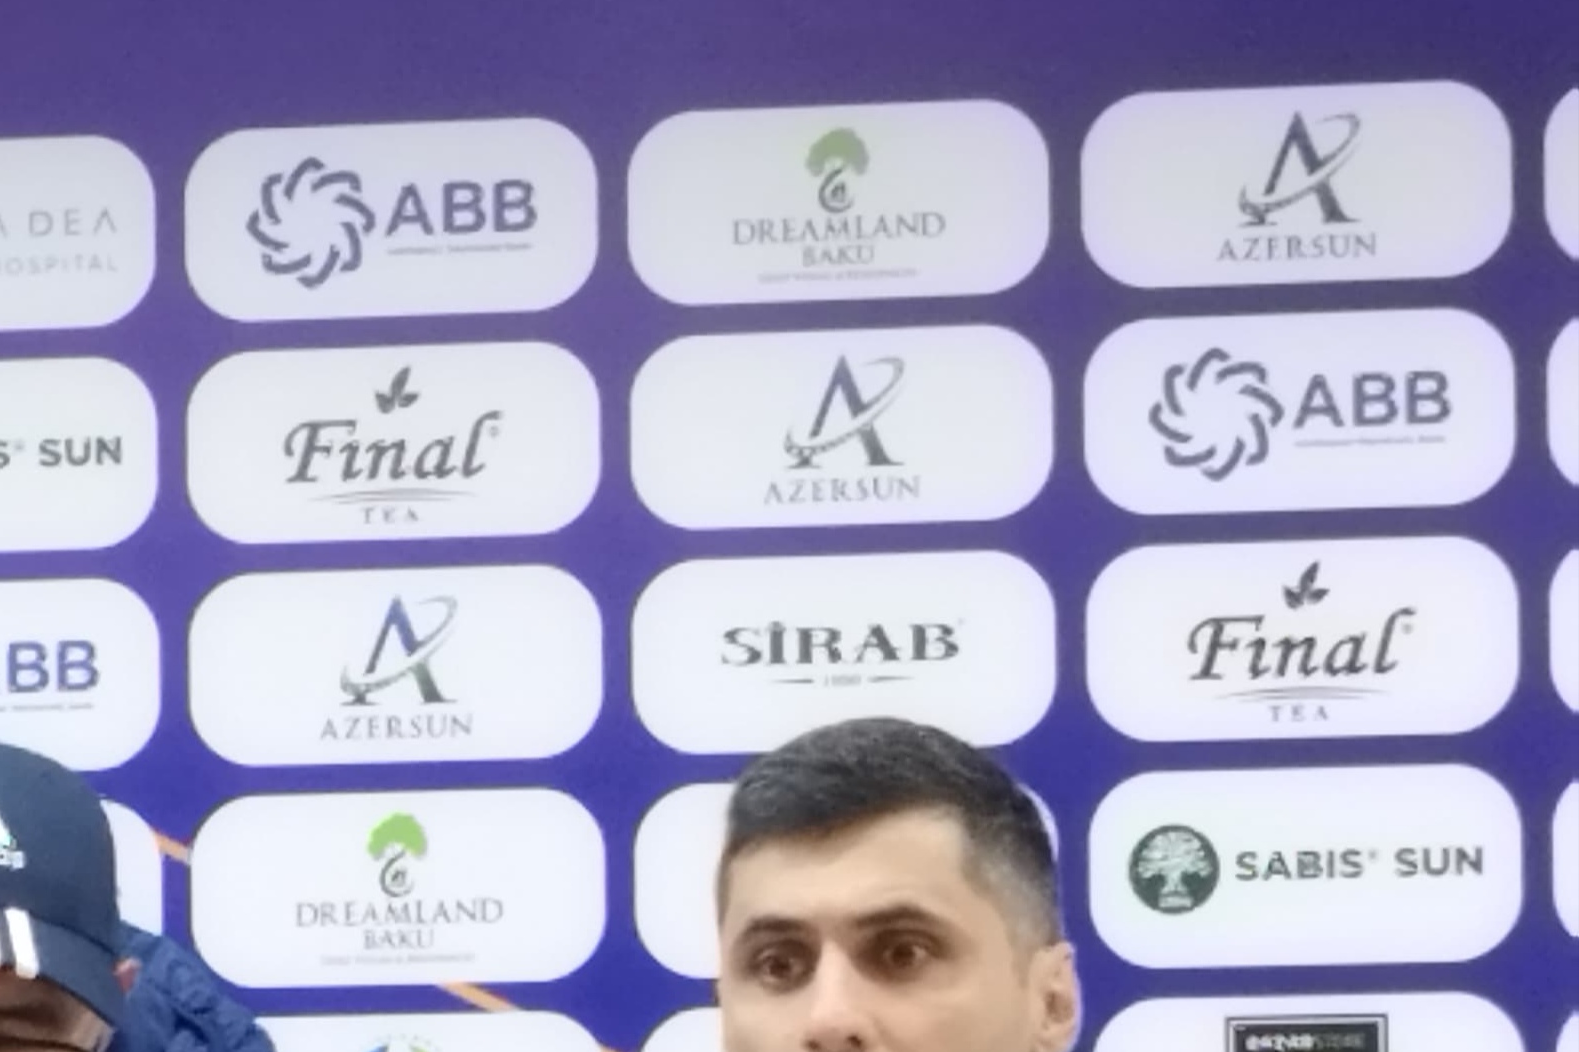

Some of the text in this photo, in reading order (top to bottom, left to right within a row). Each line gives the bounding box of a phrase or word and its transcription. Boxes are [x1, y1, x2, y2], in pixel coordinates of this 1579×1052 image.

[28, 206, 117, 238] DEA
[385, 179, 537, 237] ABB
[733, 211, 946, 245] DREAMLAND
[803, 244, 874, 267] BAKU
[1218, 233, 1376, 261] AZERSUN
[1293, 370, 1451, 429] ABB
[39, 436, 122, 467] SUN
[284, 408, 501, 483] Final
[764, 476, 919, 504] AZERSUN
[362, 506, 419, 524] TEA
[1187, 604, 1416, 680] Final
[320, 714, 472, 740] AZERSUN
[1269, 703, 1329, 722] TEA
[1395, 847, 1483, 878] SUN
[296, 898, 503, 929] DREAMLAND
[364, 930, 434, 950] BAKU
